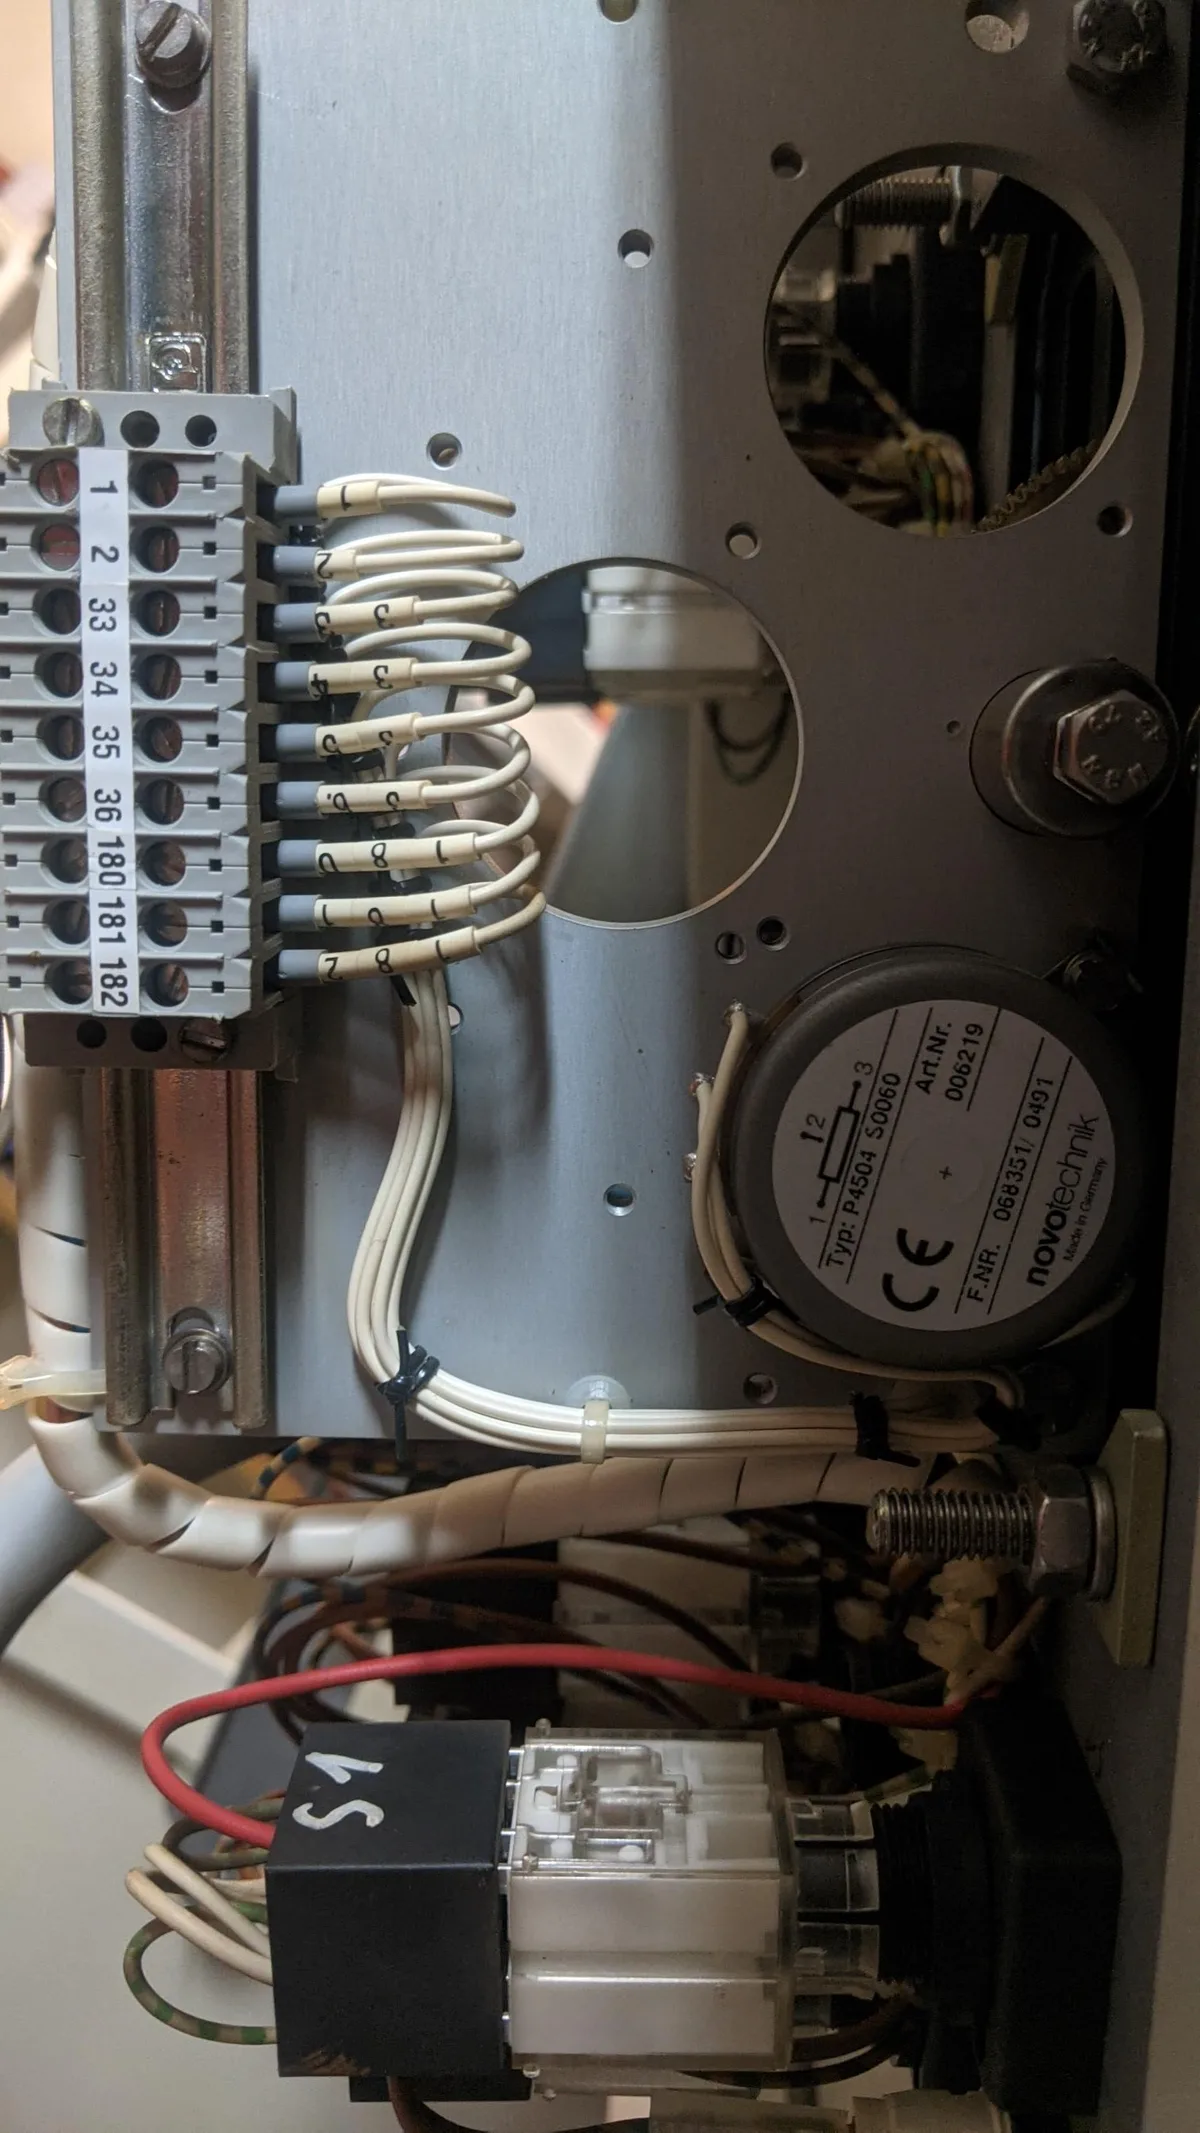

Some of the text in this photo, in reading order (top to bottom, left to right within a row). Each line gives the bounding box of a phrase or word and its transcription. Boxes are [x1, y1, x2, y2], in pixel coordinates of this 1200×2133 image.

[89, 480, 119, 494] 1
[340, 485, 353, 511] 1
[91, 545, 120, 563] 2
[315, 552, 334, 579] 2
[88, 598, 116, 632] 33
[90, 661, 119, 697] 34
[92, 725, 120, 760] 35
[93, 788, 122, 823] 36
[97, 835, 126, 887] 180
[97, 896, 127, 944] 181
[324, 940, 451, 982] 182
[100, 957, 129, 1008] 182
[854, 1060, 874, 1076] 3
[915, 1022, 953, 1095] Art.Nr.
[944, 1023, 984, 1102] 006219
[806, 1113, 825, 1130] 2
[826, 1072, 901, 1268] Typ: P4504 S0060
[808, 1214, 826, 1225] 1
[1026, 1113, 1100, 1288] novotechnik
[1063, 1227, 1084, 1263] Made
[1080, 1156, 1109, 1213] Germany
[967, 1244, 1001, 1302] F.NR.
[292, 1751, 386, 1830] S1
